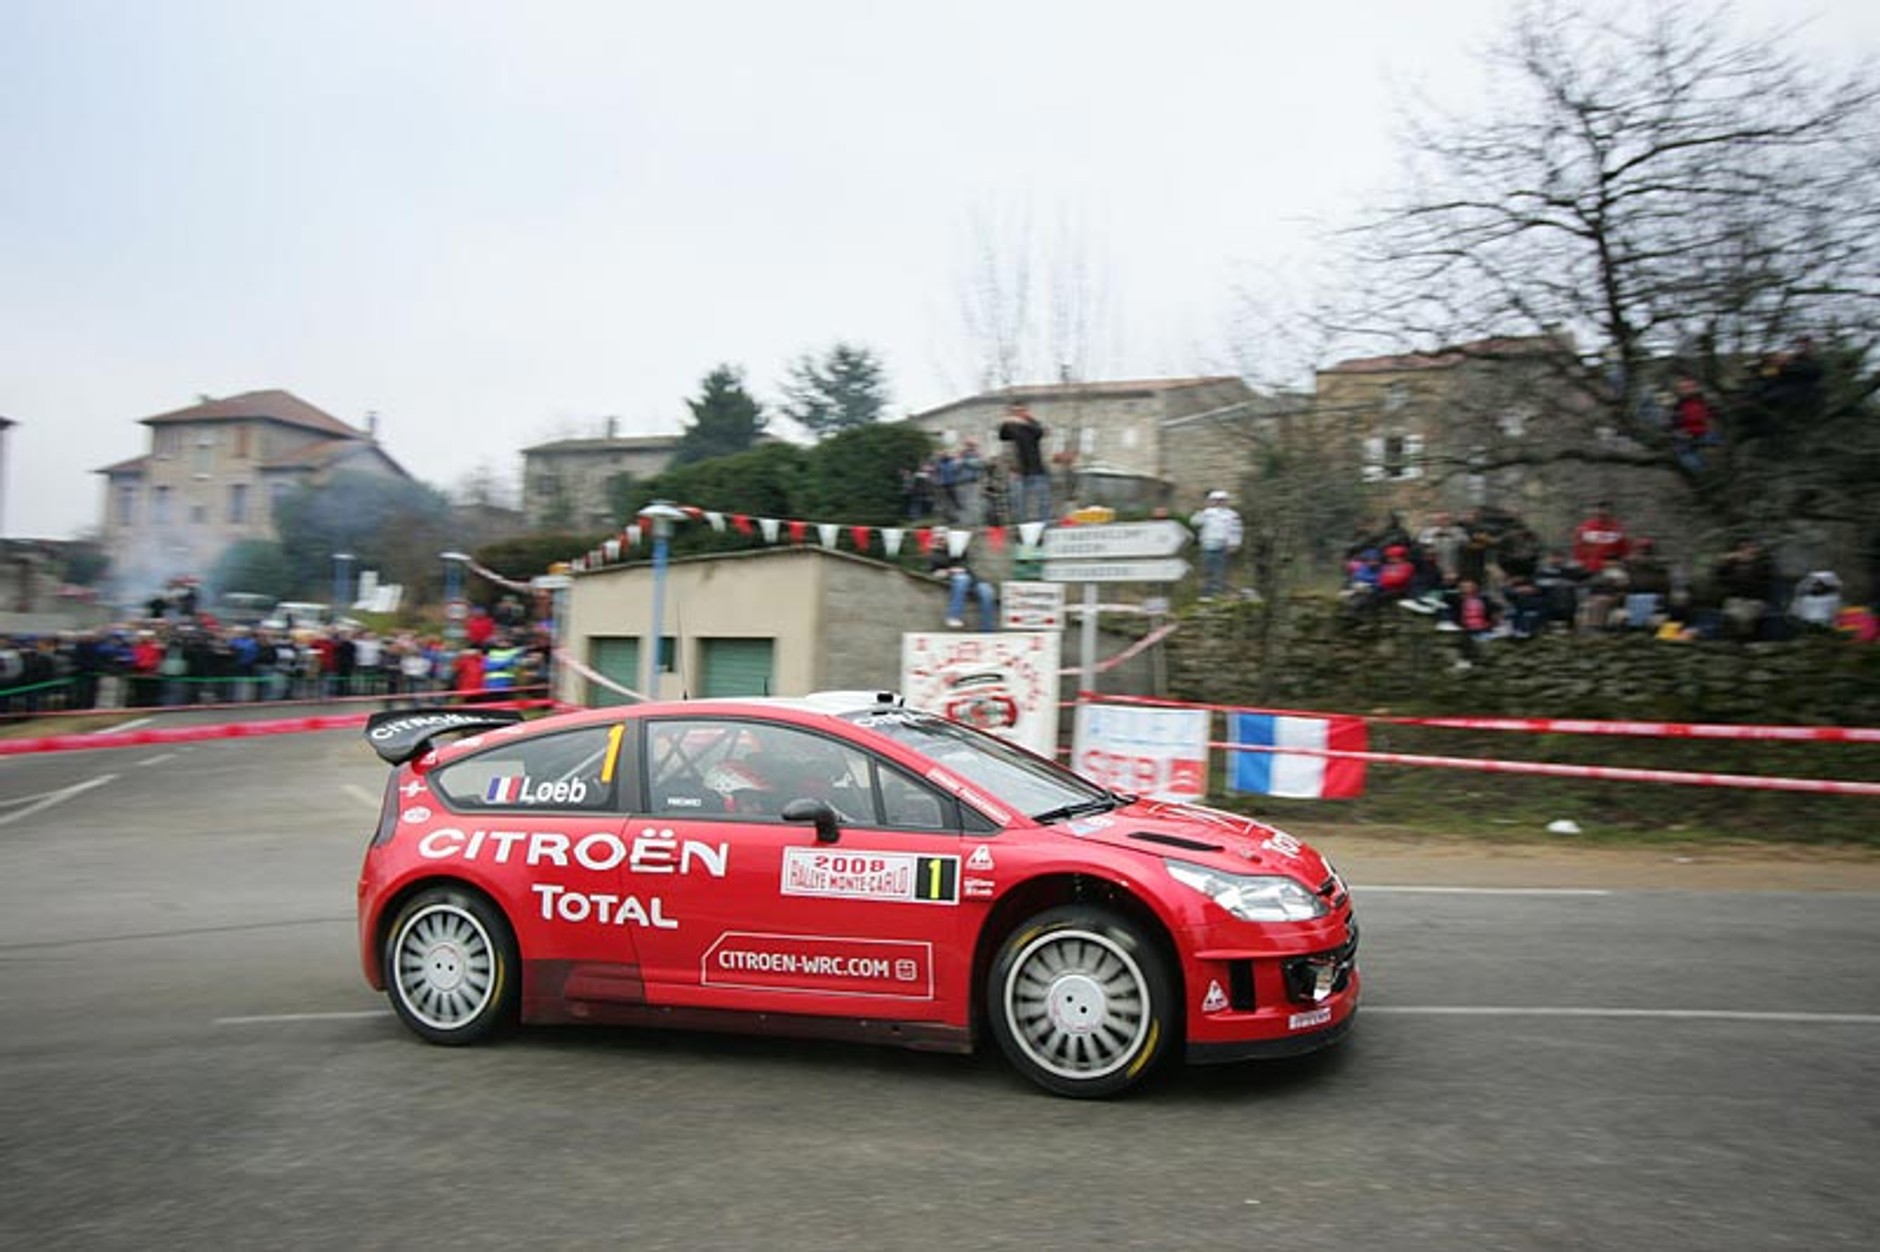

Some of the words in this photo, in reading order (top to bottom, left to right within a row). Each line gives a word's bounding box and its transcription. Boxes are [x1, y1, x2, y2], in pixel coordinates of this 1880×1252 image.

[601, 723, 625, 784] 1
[520, 777, 587, 803] Loeb
[418, 828, 728, 877] CITROËN
[815, 855, 885, 875] 2008
[790, 859, 826, 890] RALLYE
[928, 858, 941, 900] 1
[718, 949, 890, 977] CITROEN-WRC.COM
